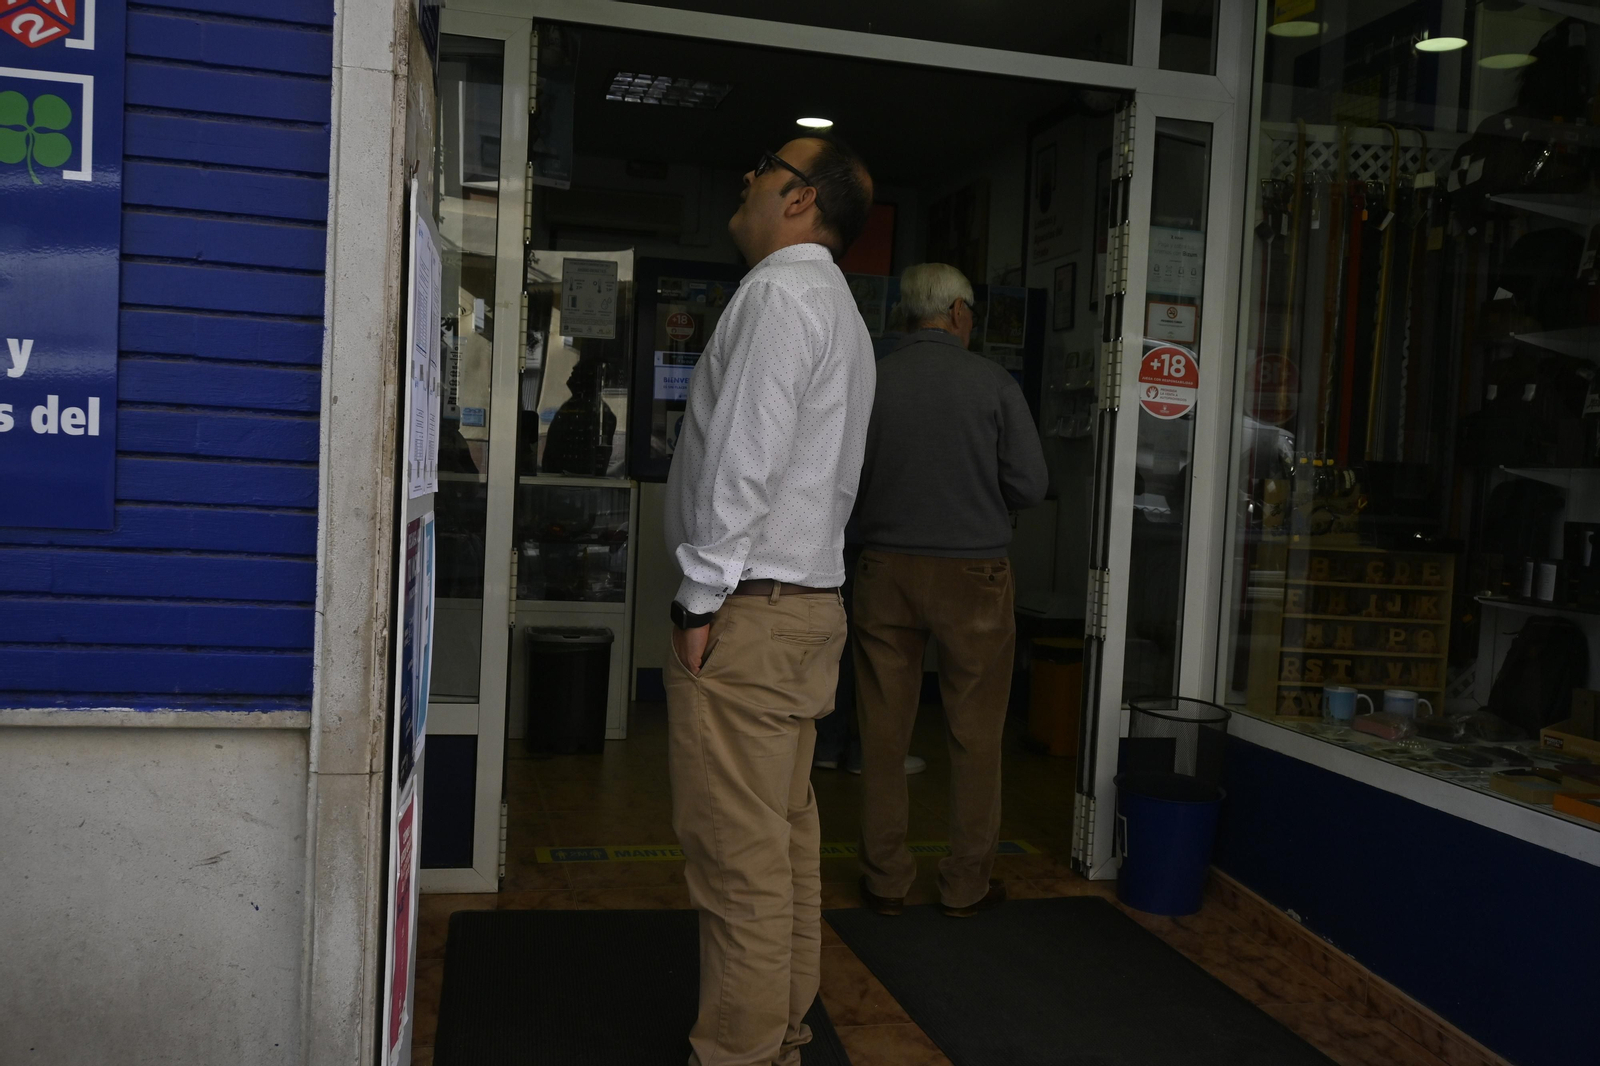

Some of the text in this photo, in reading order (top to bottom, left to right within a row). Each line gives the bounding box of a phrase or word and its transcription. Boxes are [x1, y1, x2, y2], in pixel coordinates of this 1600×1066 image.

[672, 315, 688, 325] +18
[6, 338, 35, 379] y
[1150, 354, 1186, 378] +18
[31, 395, 100, 437] del
